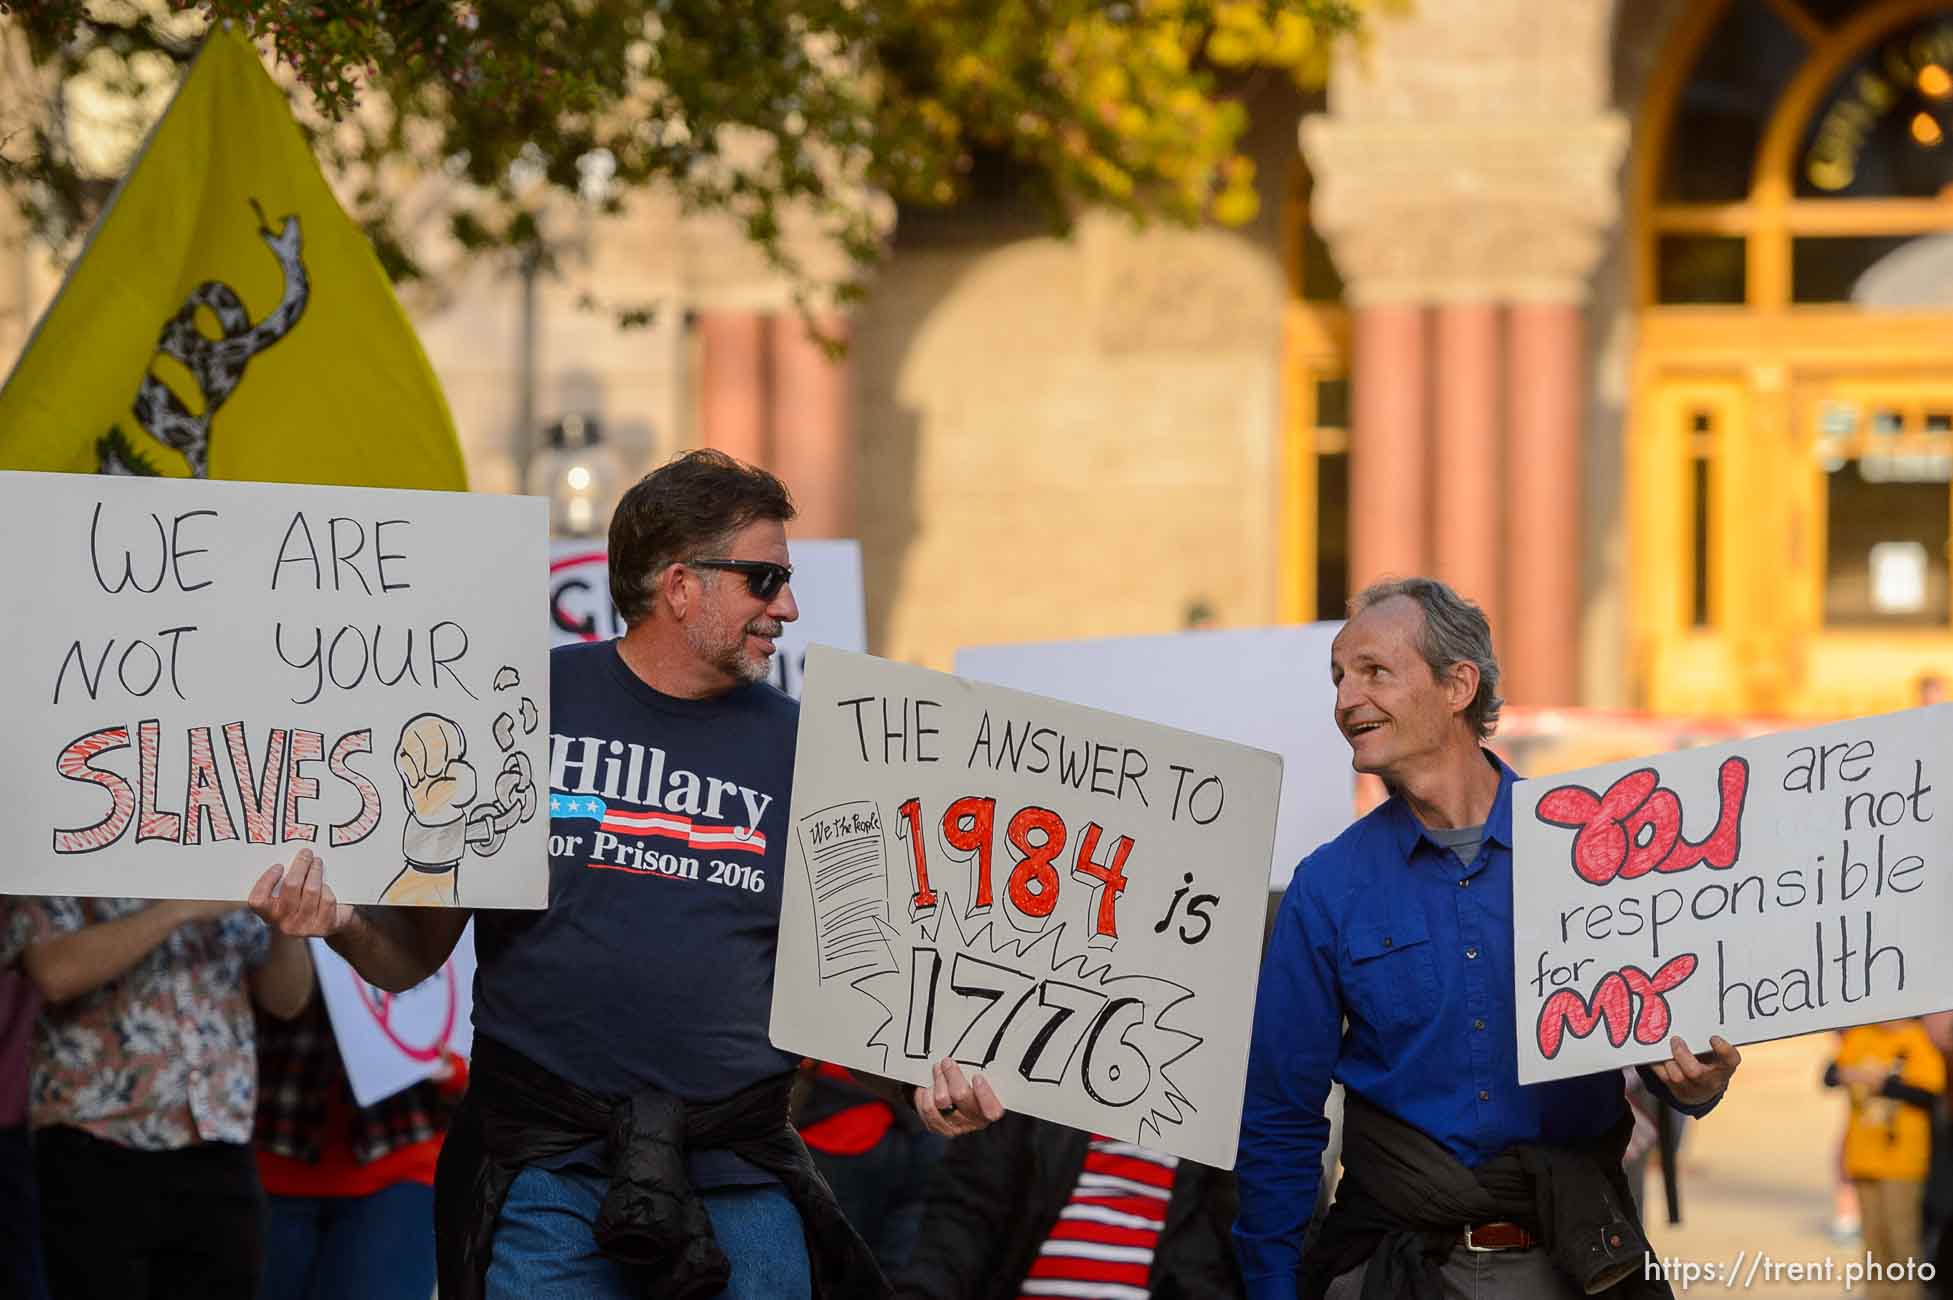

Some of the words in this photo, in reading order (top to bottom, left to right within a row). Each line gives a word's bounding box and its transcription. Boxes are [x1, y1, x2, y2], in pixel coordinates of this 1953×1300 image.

[91, 502, 218, 594] WE
[272, 511, 411, 596] ARE
[53, 625, 198, 705] NOT
[53, 718, 382, 854] SLAVES
[550, 733, 773, 841] Hillary
[837, 696, 943, 765] THE
[968, 709, 1149, 807] ANSWER
[1170, 764, 1225, 825] TO
[1783, 739, 1875, 793] are
[1844, 759, 1934, 831] not
[549, 834, 584, 857] or
[590, 831, 700, 880] Prison
[706, 859, 766, 893] 2016
[809, 820, 833, 845] We
[896, 795, 1136, 949] 1984
[1154, 871, 1220, 945] is
[1560, 833, 1925, 958] responsible
[1530, 951, 1596, 998] for
[1717, 911, 1905, 1025] health
[903, 946, 1152, 1108] 1776
